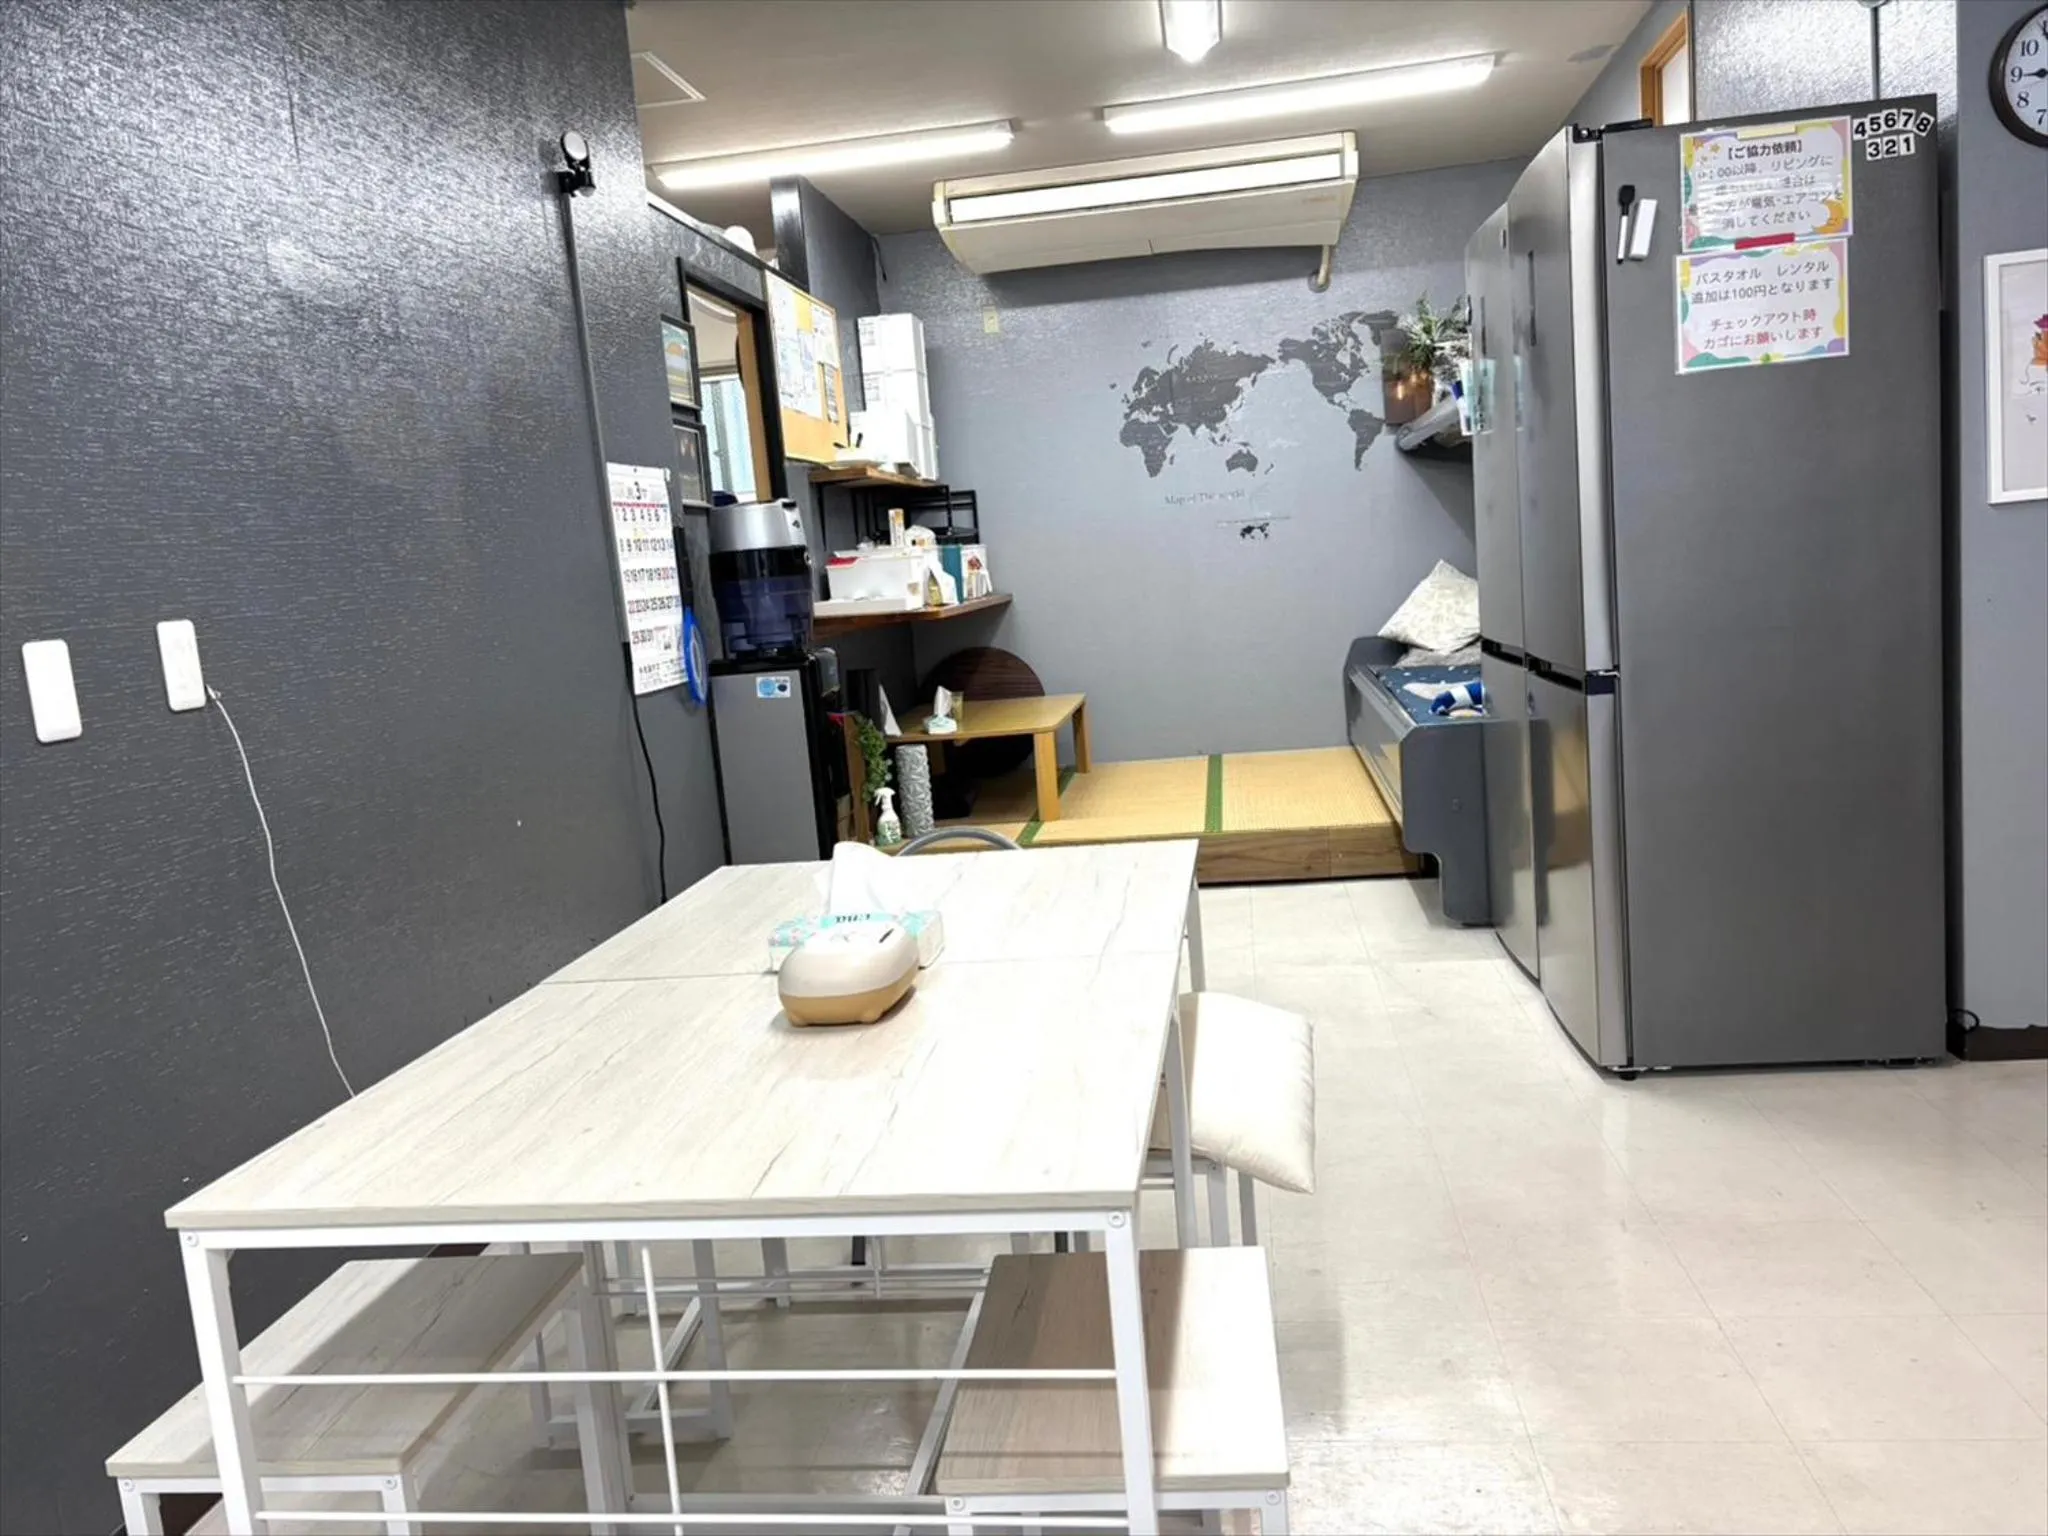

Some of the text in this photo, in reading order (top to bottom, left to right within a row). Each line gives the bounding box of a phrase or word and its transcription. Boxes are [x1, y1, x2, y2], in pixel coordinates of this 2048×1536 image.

[2020, 39, 2040, 57] 10
[2010, 66, 2023, 83] 9
[2016, 91, 2030, 108] 8
[2036, 108, 2047, 126] 7
[1728, 140, 1802, 160] 【ご協力依頼】
[1721, 210, 1812, 230] 消してください
[1696, 260, 1830, 286] バスタオル レンタル
[1692, 277, 1834, 305] 追加は100円となります
[1710, 308, 1817, 332] チェックアウト時
[1704, 326, 1823, 350] カゴにお願いします
